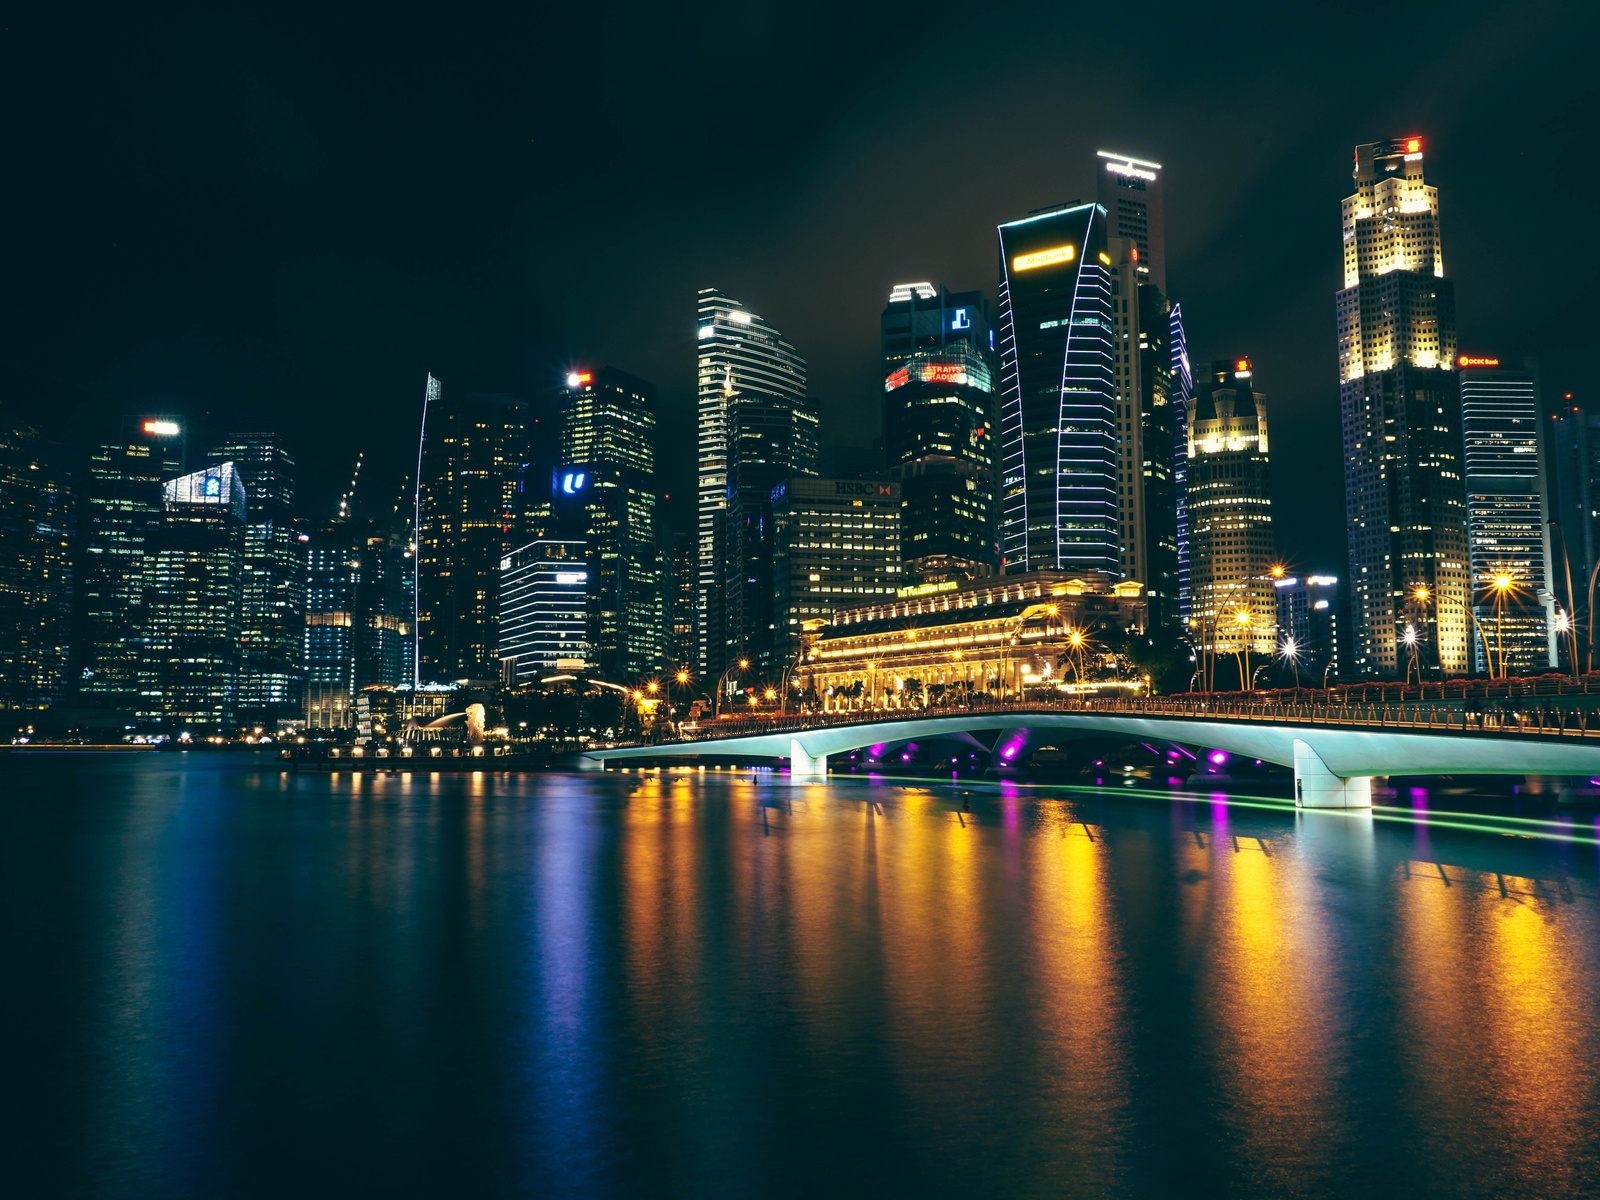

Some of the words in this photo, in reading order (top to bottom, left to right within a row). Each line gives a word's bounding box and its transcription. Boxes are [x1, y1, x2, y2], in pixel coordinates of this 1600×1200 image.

[1027, 250, 1067, 264] Maybank
[835, 482, 873, 495] HSBC
[897, 588, 907, 597] THE
[908, 584, 938, 596] FULLERTON
[938, 581, 958, 591] HOTEL
